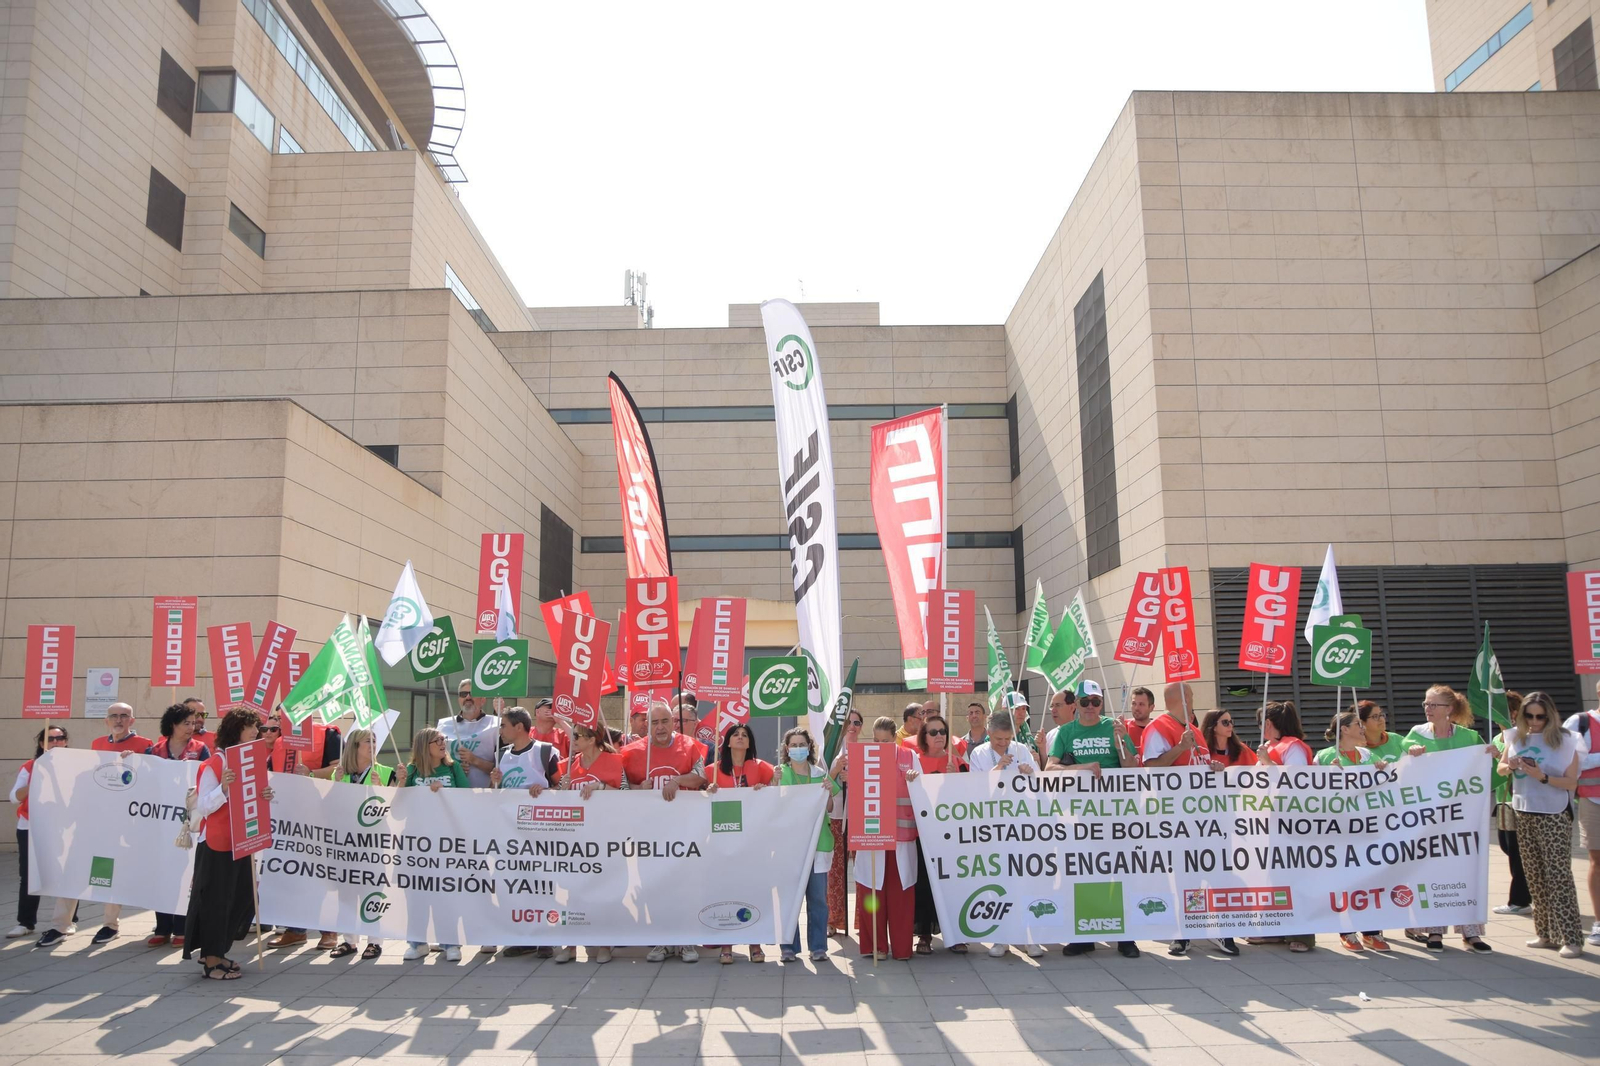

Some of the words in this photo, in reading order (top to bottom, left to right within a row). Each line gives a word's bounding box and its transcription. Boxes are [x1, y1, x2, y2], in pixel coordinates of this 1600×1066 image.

[490, 534, 511, 610] UGT
[636, 582, 669, 658] UGT
[1133, 576, 1160, 638] UGT
[1162, 572, 1188, 649] UGT
[1254, 569, 1290, 642] UGT
[712, 600, 732, 668] CCOO
[944, 592, 960, 660] CCOO
[40, 627, 60, 689] CCOO
[166, 625, 182, 685] CCOO
[222, 626, 244, 688] CCOO
[258, 626, 287, 690] CCOO
[484, 660, 522, 676] CSIF
[568, 614, 596, 698] UGT
[1324, 647, 1364, 664] CSIF
[761, 675, 800, 696] CSIF
[1072, 737, 1110, 749] SATSE
[1072, 748, 1110, 756] GRANADA
[240, 745, 258, 820] CCOO
[864, 745, 880, 816] CCOO
[1012, 772, 1182, 793] CUMPLIMIENTO
[1189, 772, 1216, 790] DE
[1224, 771, 1270, 788] LOS
[128, 801, 188, 822] CONTR
[536, 809, 571, 818] CCOO
[935, 800, 1030, 822] CONTRA
[1037, 800, 1064, 818] LA
[1070, 798, 1139, 818] FALTA
[1146, 796, 1174, 816] DE
[1182, 792, 1360, 814] CONTRATACIÓN
[1365, 790, 1394, 809] EN
[1400, 786, 1432, 805] EL
[1437, 776, 1484, 799] SAS
[270, 818, 432, 854] SMANTELAMIENTO
[438, 836, 466, 854] DE
[473, 838, 501, 855] LA
[506, 839, 600, 858] SANIDAD
[606, 836, 702, 858] PÚBLICA
[714, 822, 740, 831] SATSE
[958, 823, 1067, 844] LISTADOS
[1074, 822, 1104, 840] DE
[1112, 821, 1195, 839] BOLSA
[1194, 820, 1227, 840] YA,
[1234, 818, 1269, 836] SIN
[1278, 818, 1342, 835] NOTA
[1348, 816, 1378, 834] DE
[1385, 802, 1464, 831] CORTE
[272, 839, 322, 856] ERDOS
[326, 848, 402, 866] FIRMADOS
[406, 856, 440, 868] SON
[446, 858, 490, 870] PARA
[495, 860, 602, 874] CUMPLIRLOS
[931, 857, 950, 880] L
[956, 853, 1002, 878] SAS
[1008, 852, 1058, 877] NOS
[1065, 846, 1173, 876] ENGAÑA!
[1184, 848, 1216, 873] NO
[1222, 847, 1250, 871] LO
[1255, 844, 1337, 870] VAMOS
[1344, 844, 1360, 868] A
[90, 877, 112, 886] SATSE
[397, 874, 496, 894] DIMISIÓN
[504, 879, 554, 895] YA!!!
[1431, 882, 1467, 890] Granada
[512, 909, 544, 922] UGT
[970, 900, 1013, 920] CSIF
[1212, 892, 1272, 908] CCOO
[1329, 888, 1386, 913] UGT
[1078, 918, 1122, 932] SATSE
